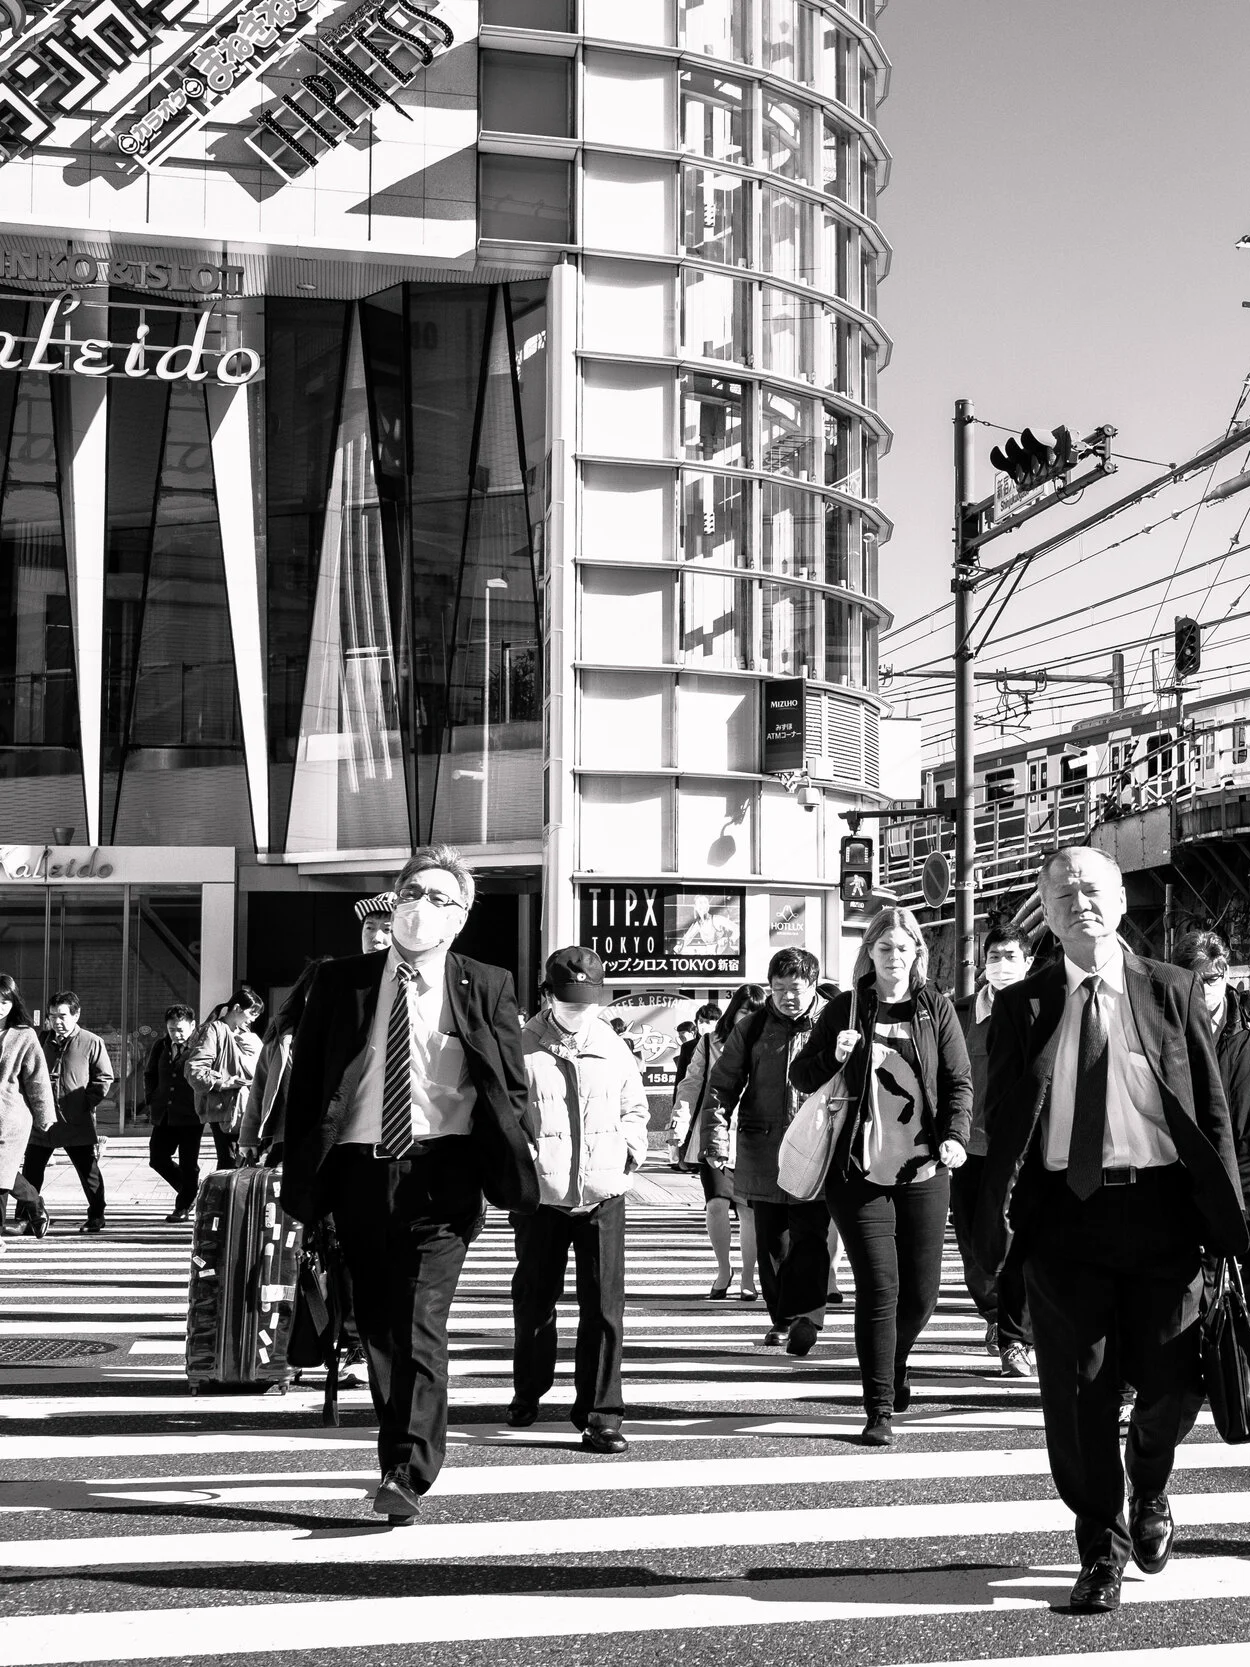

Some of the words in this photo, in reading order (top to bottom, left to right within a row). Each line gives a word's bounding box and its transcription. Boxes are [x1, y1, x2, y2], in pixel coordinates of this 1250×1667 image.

[256, 0, 454, 167] TIPNESS
[130, 88, 188, 143] カラオケ
[770, 699, 798, 709] MIZUHO
[775, 722, 793, 731] みずほ
[766, 730, 802, 740] ATMコーナー
[770, 922, 804, 931] HOTLUX
[591, 936, 655, 954] TOKYO
[669, 958, 716, 971] TOKYO
[717, 958, 740, 972] 新宿
[638, 996, 645, 1007] &
